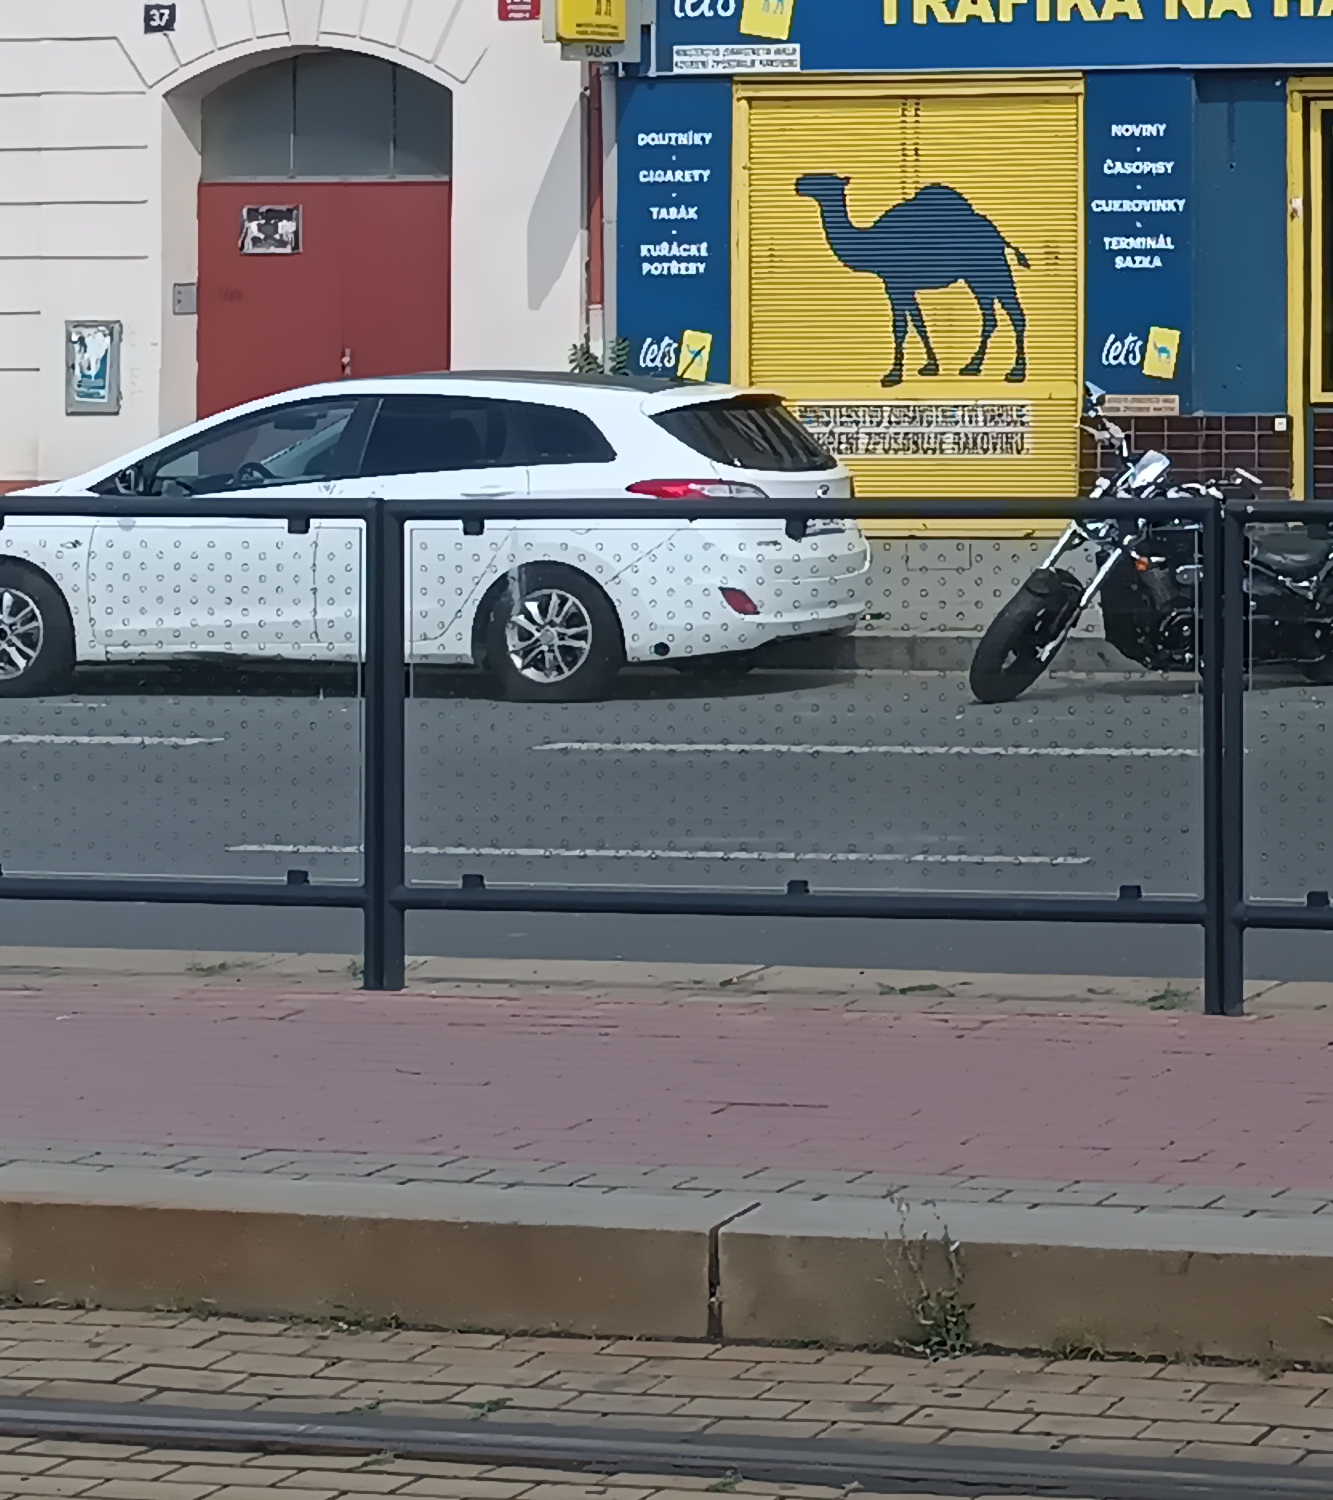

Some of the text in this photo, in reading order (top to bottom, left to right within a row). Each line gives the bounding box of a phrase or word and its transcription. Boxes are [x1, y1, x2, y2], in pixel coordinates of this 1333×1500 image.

[149, 8, 170, 27] 37
[1111, 123, 1167, 137] NOVINY
[1103, 158, 1175, 176] ČASOPISY
[638, 169, 711, 183] CIGARETY
[649, 204, 699, 220] TABÁK
[1091, 198, 1186, 212] CUKROVINKY
[1103, 233, 1175, 250] TERMINÁL
[1114, 255, 1163, 270] SAZKA
